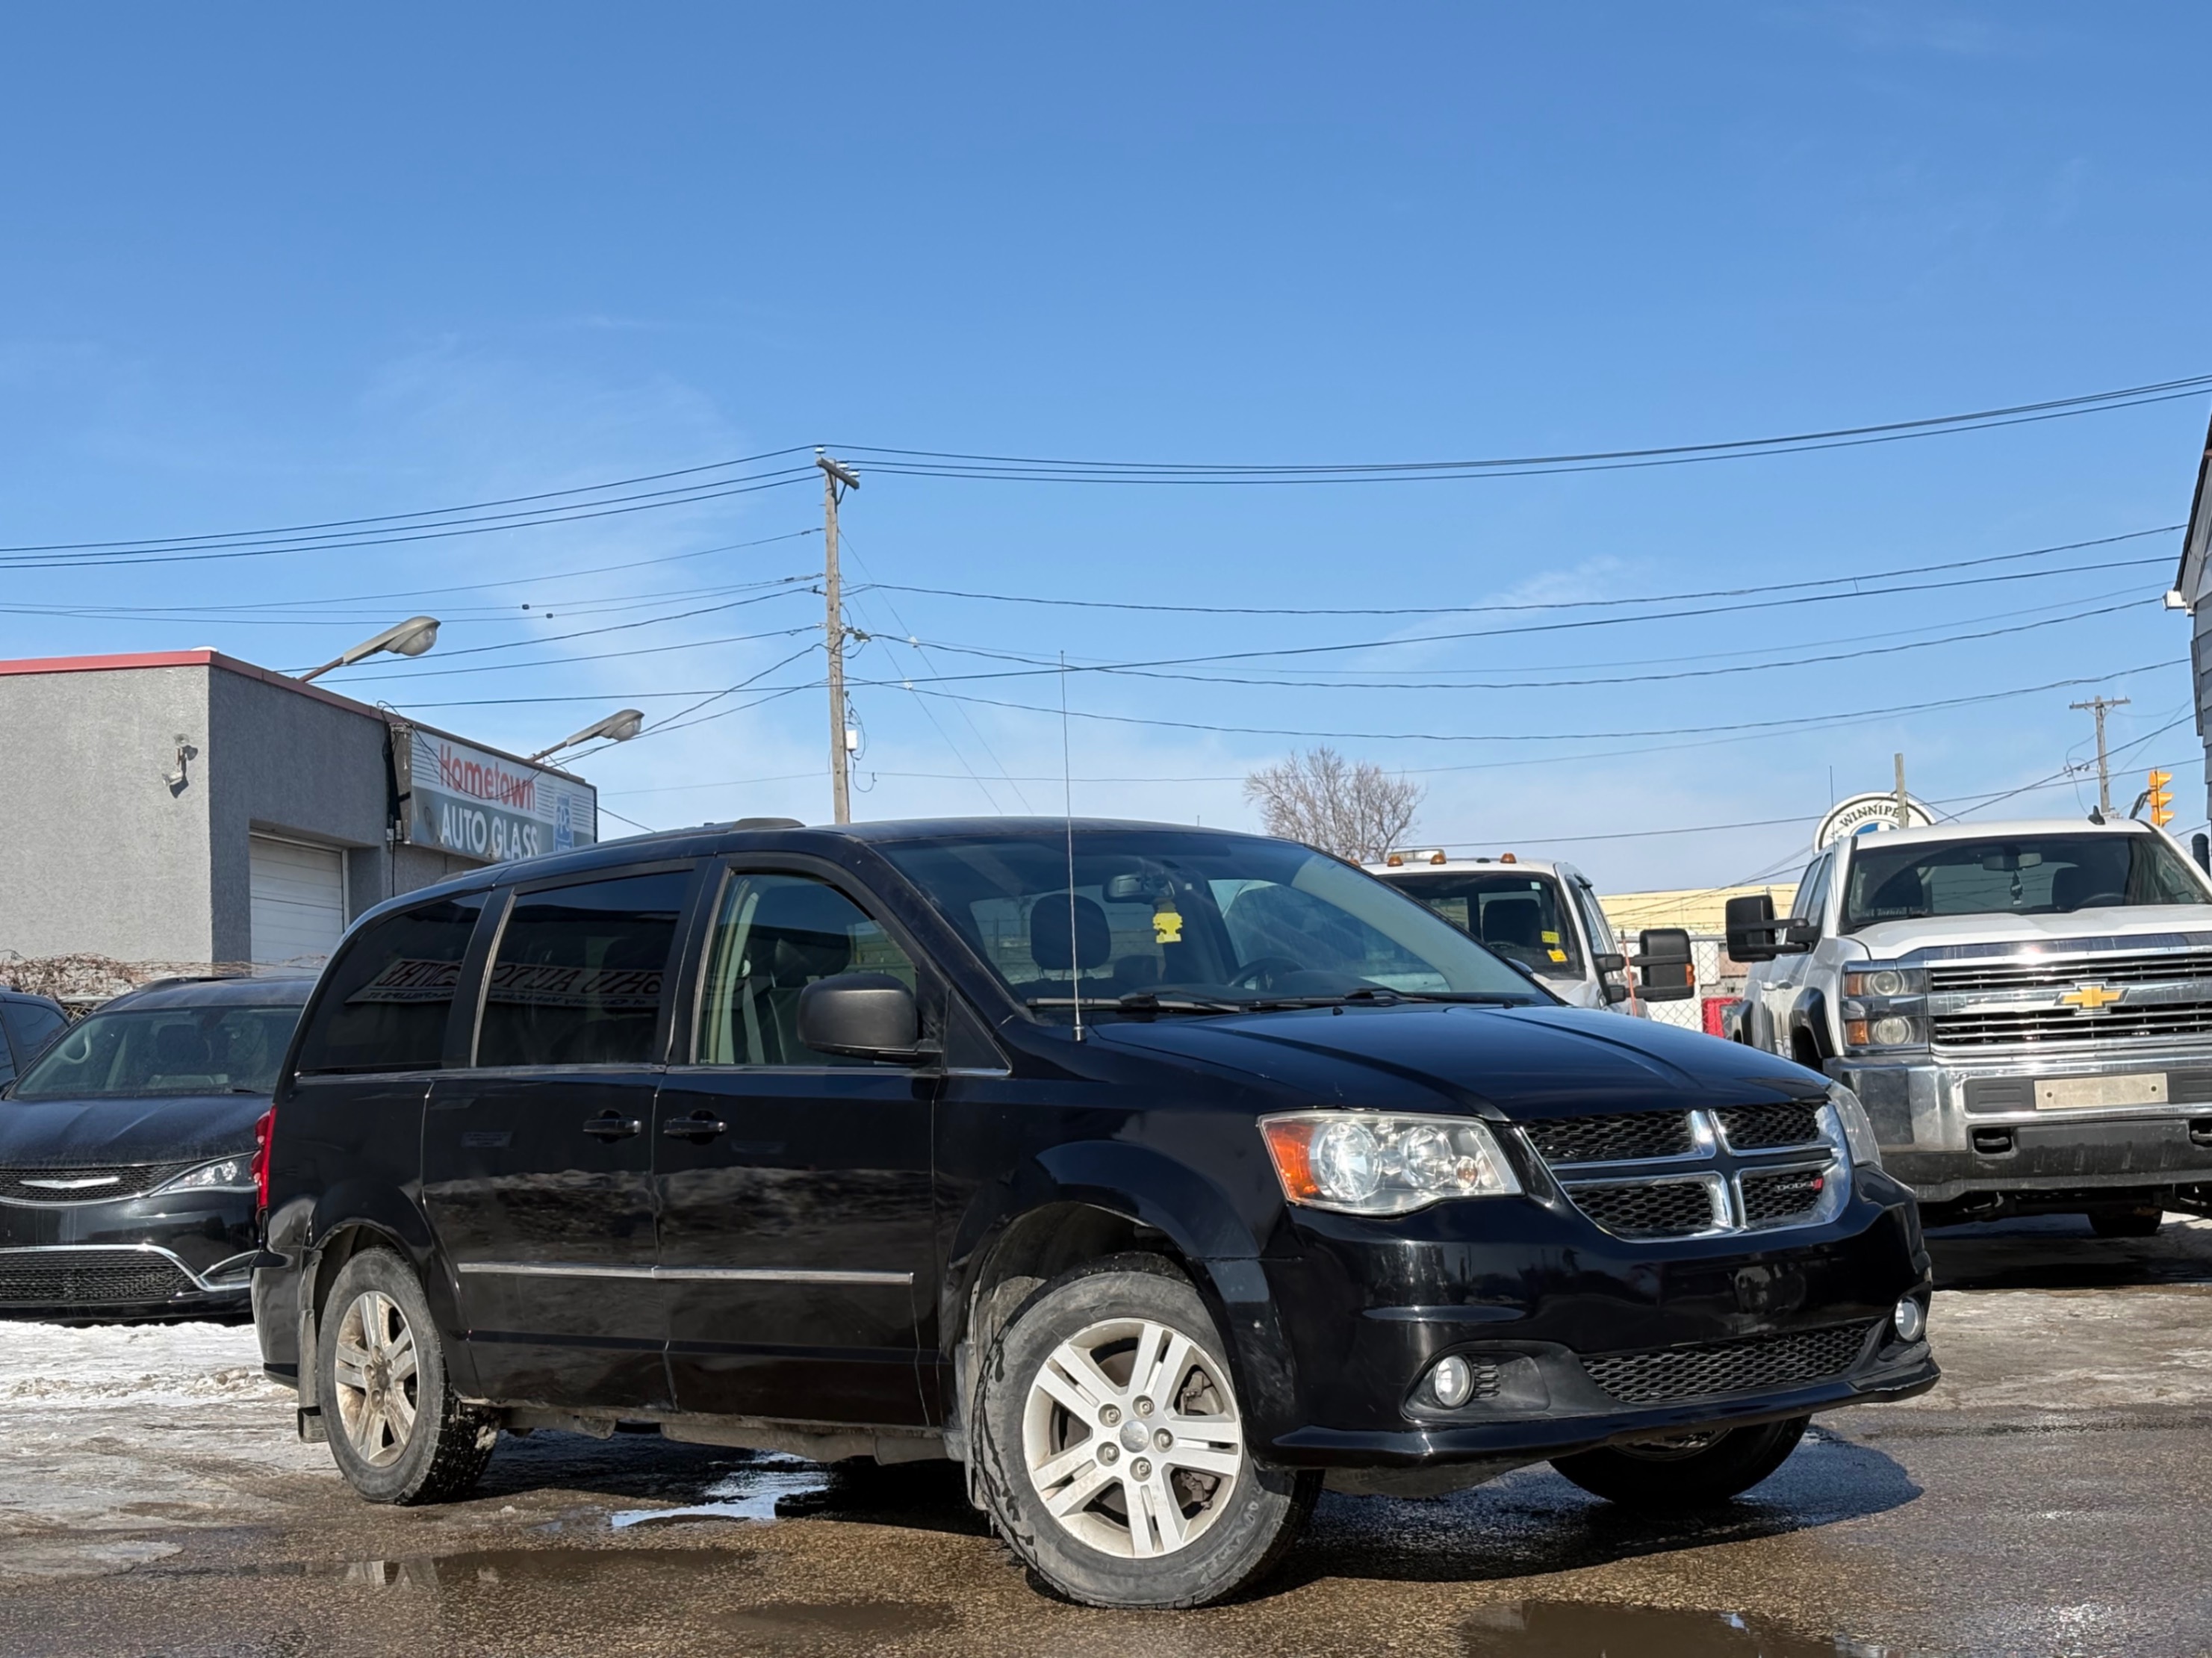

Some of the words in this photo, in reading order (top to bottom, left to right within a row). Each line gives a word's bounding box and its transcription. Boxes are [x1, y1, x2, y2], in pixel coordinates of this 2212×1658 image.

[439, 743, 536, 812] Hometown
[440, 803, 486, 853] AUTO
[491, 816, 538, 860] GLASS
[1839, 804, 1901, 828] WINNIPE
